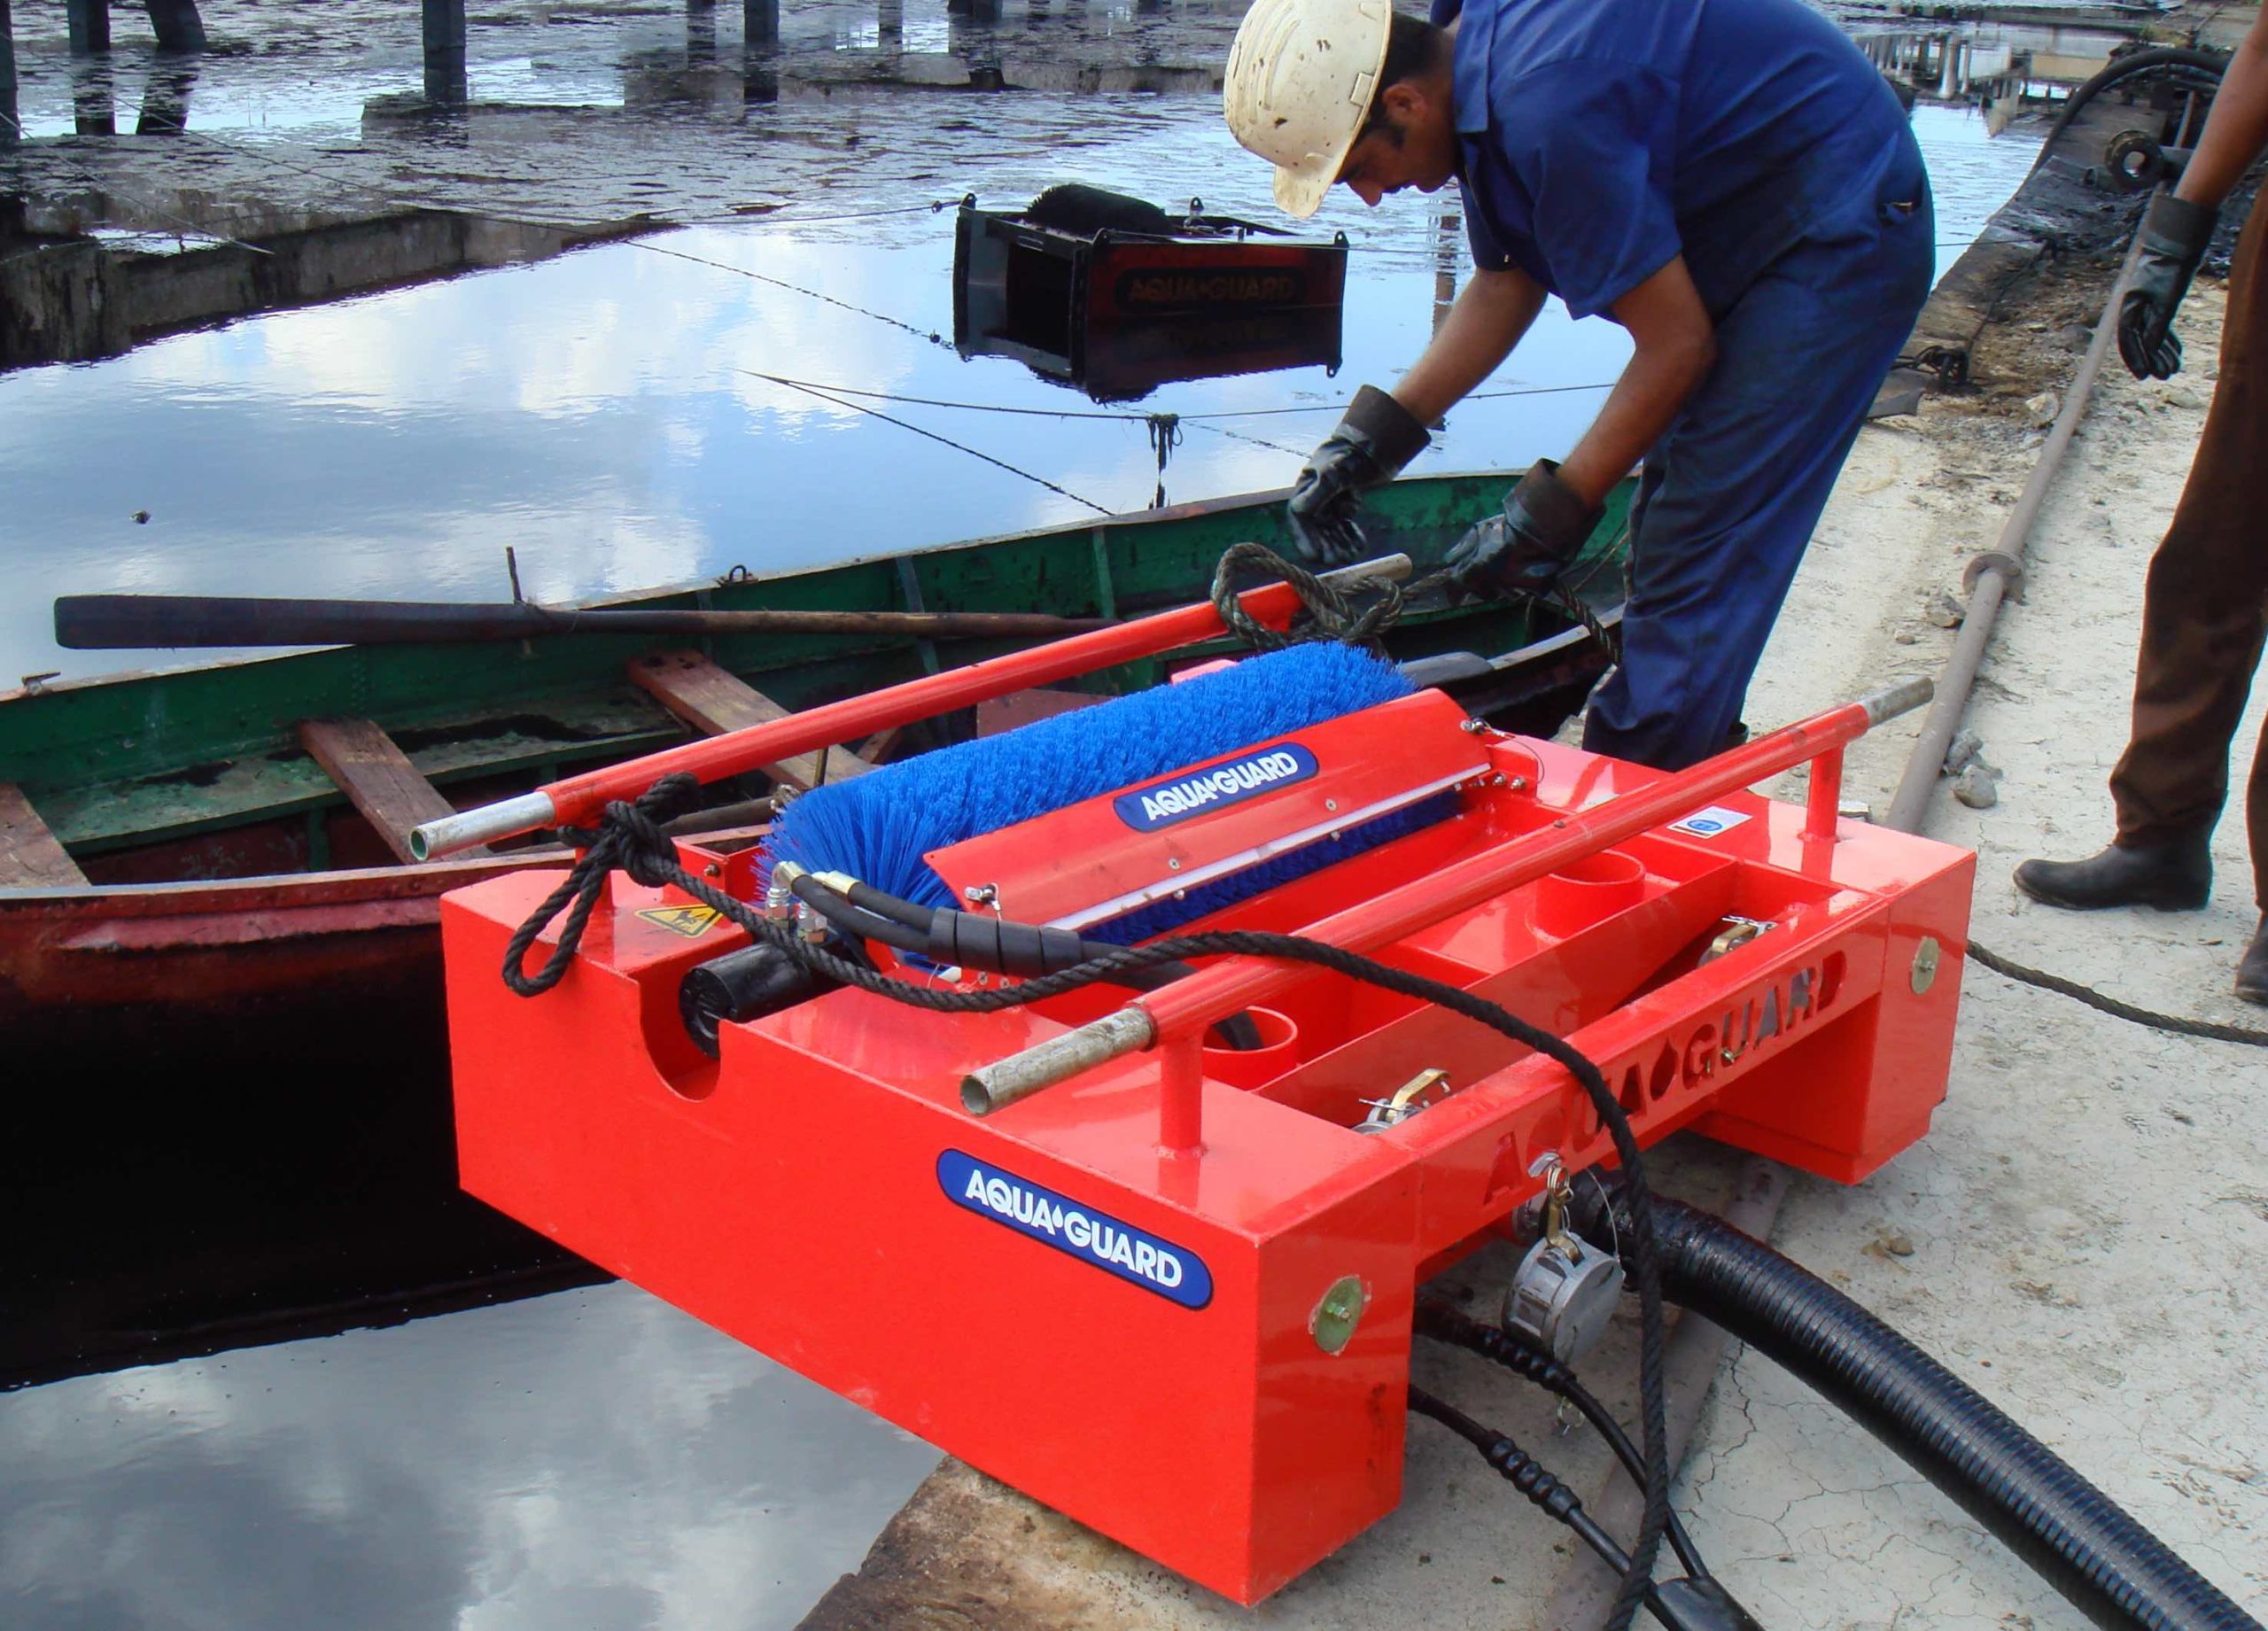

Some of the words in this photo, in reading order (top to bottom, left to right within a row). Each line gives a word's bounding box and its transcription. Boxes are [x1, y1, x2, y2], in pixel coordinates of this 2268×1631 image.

[1128, 276, 1200, 303] AQUA
[1208, 274, 1294, 302] GUARD
[1140, 780, 1219, 821] AQUA
[1211, 751, 1299, 795] GUARD
[1682, 950, 1847, 1090] GUARD
[965, 1169, 1056, 1236] AQUA
[1064, 1210, 1183, 1288] GUARD
